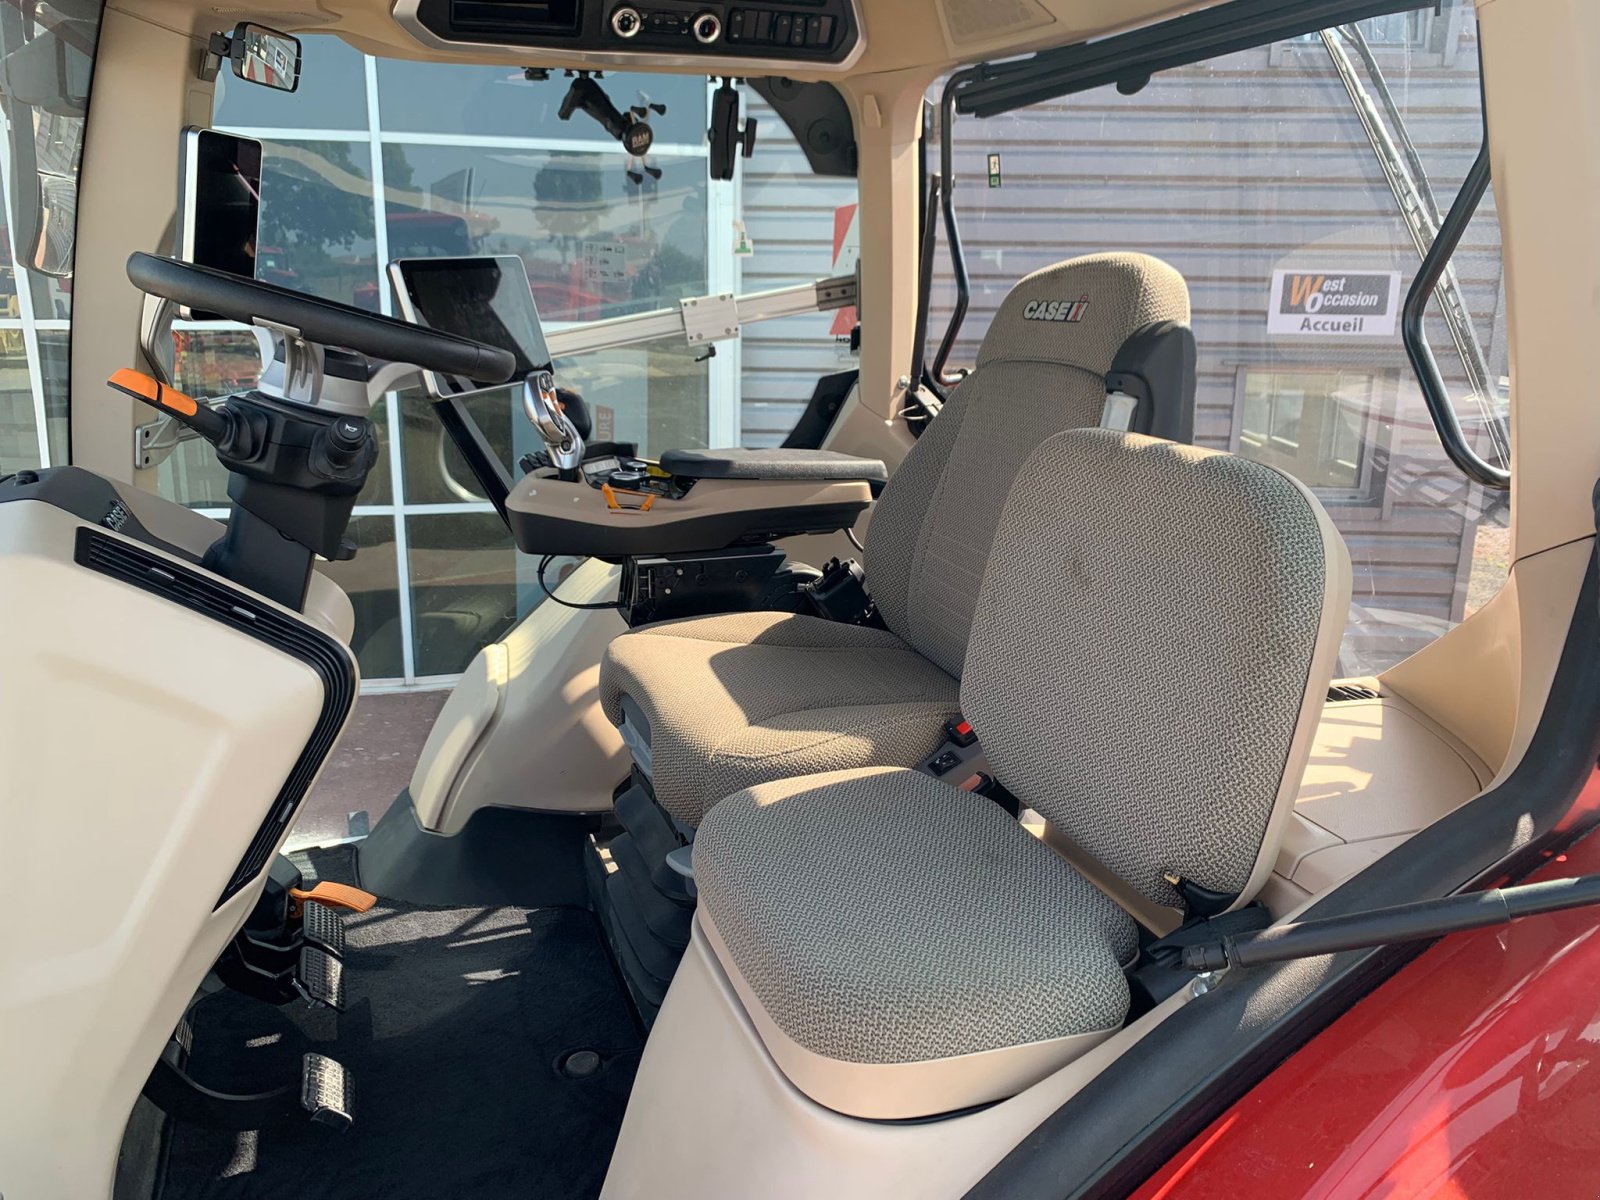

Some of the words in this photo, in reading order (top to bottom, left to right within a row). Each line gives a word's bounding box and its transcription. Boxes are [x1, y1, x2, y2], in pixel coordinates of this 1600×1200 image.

[631, 132, 650, 148] RAM
[1290, 275, 1346, 308] West
[1023, 300, 1072, 321] CASE
[1305, 292, 1379, 314] Occasion
[1300, 317, 1364, 332] Accueil
